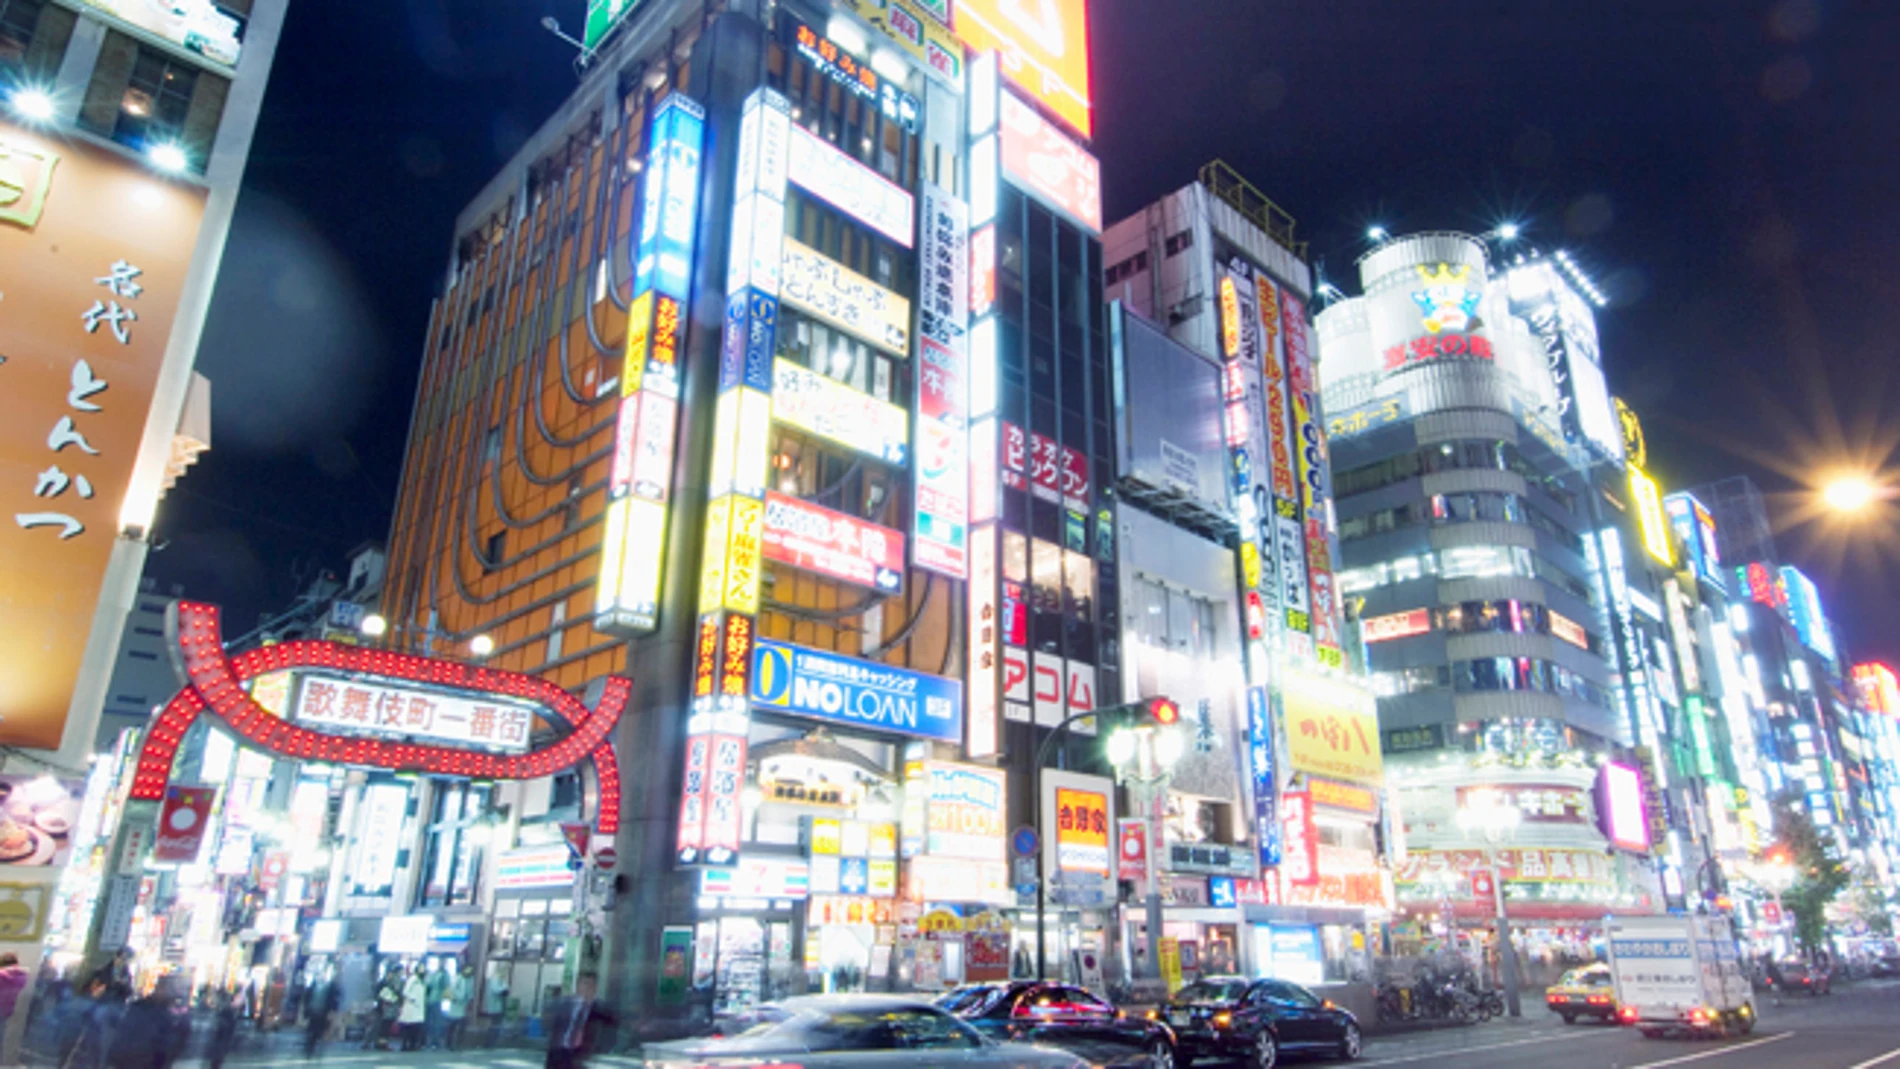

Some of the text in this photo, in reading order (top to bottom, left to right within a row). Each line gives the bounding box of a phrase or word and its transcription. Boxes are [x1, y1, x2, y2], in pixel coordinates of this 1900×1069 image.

[1004, 656, 1093, 710] アコム
[303, 682, 527, 743] 歌舞伎町一番街
